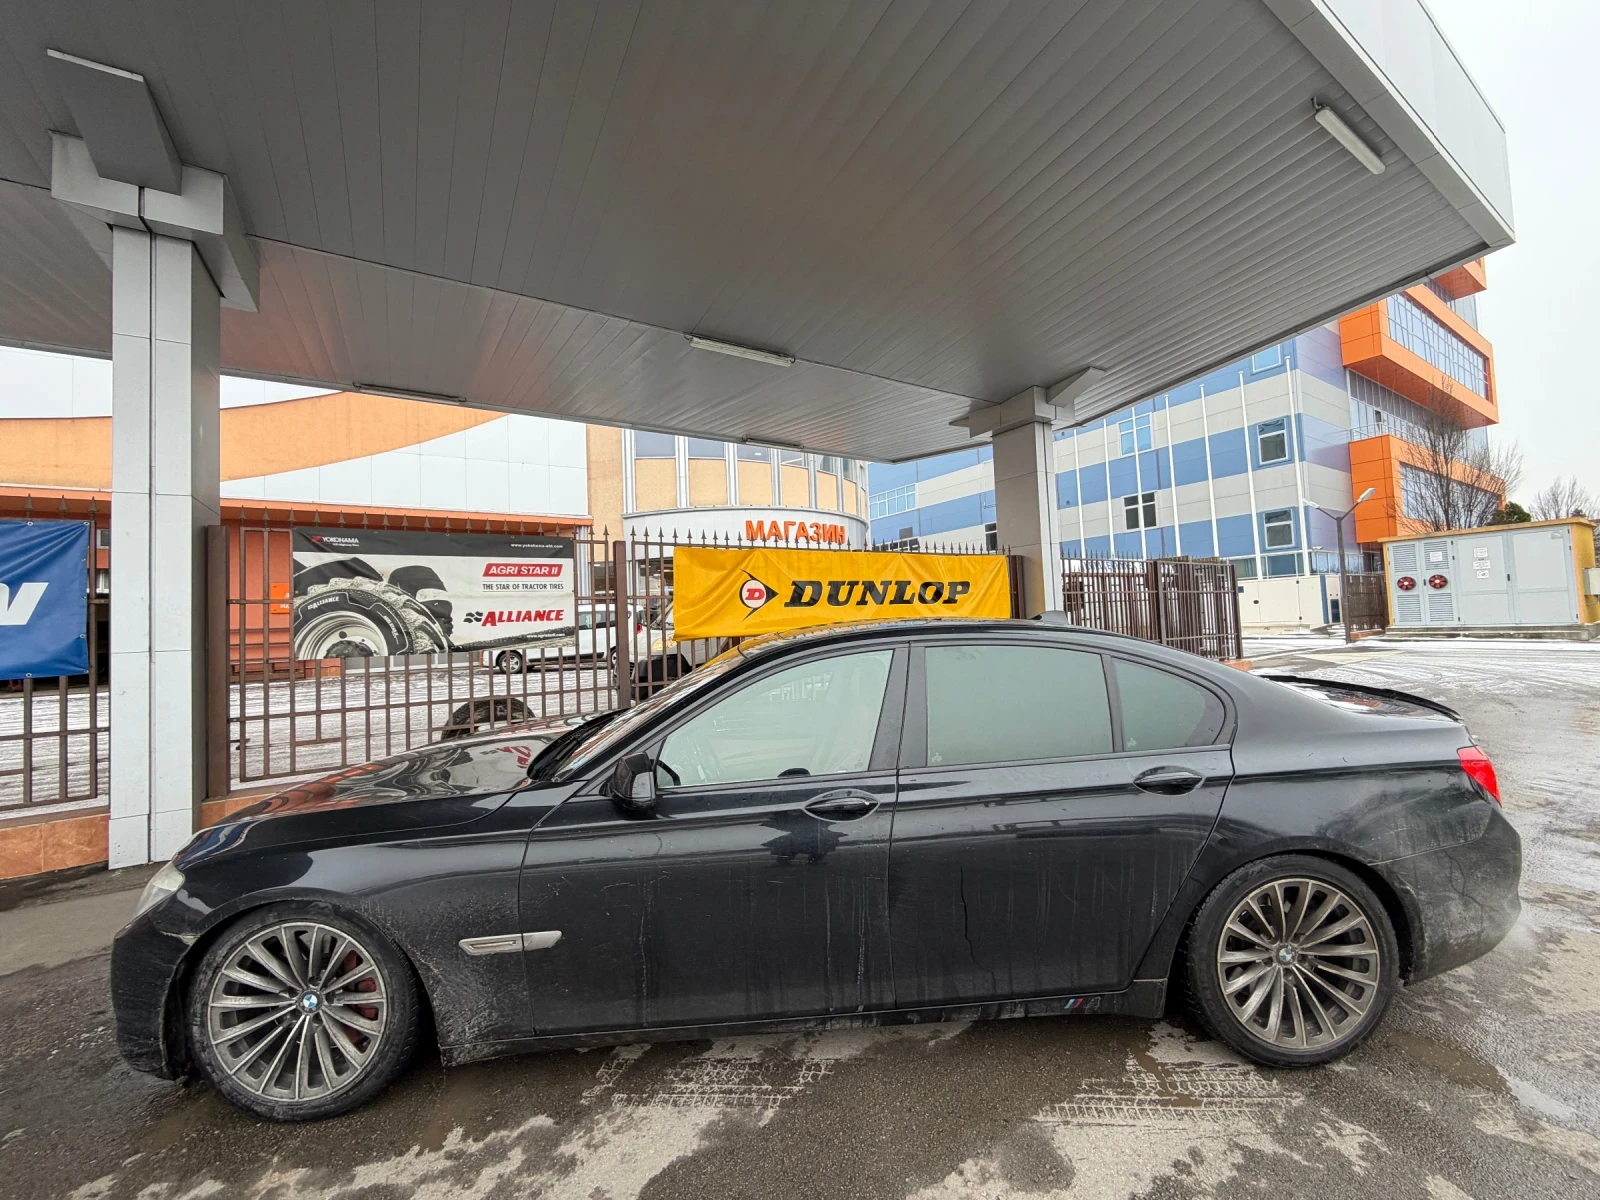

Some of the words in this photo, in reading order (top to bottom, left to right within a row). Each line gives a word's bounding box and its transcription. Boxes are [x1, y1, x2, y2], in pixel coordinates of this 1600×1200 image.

[745, 520, 846, 544] МАГАЗИН
[488, 566, 518, 575] AGRI
[520, 566, 549, 575] STAR
[312, 596, 340, 609] ALLIANCE
[783, 580, 971, 608] DUNLOP
[481, 609, 565, 627] ALLIANCE
